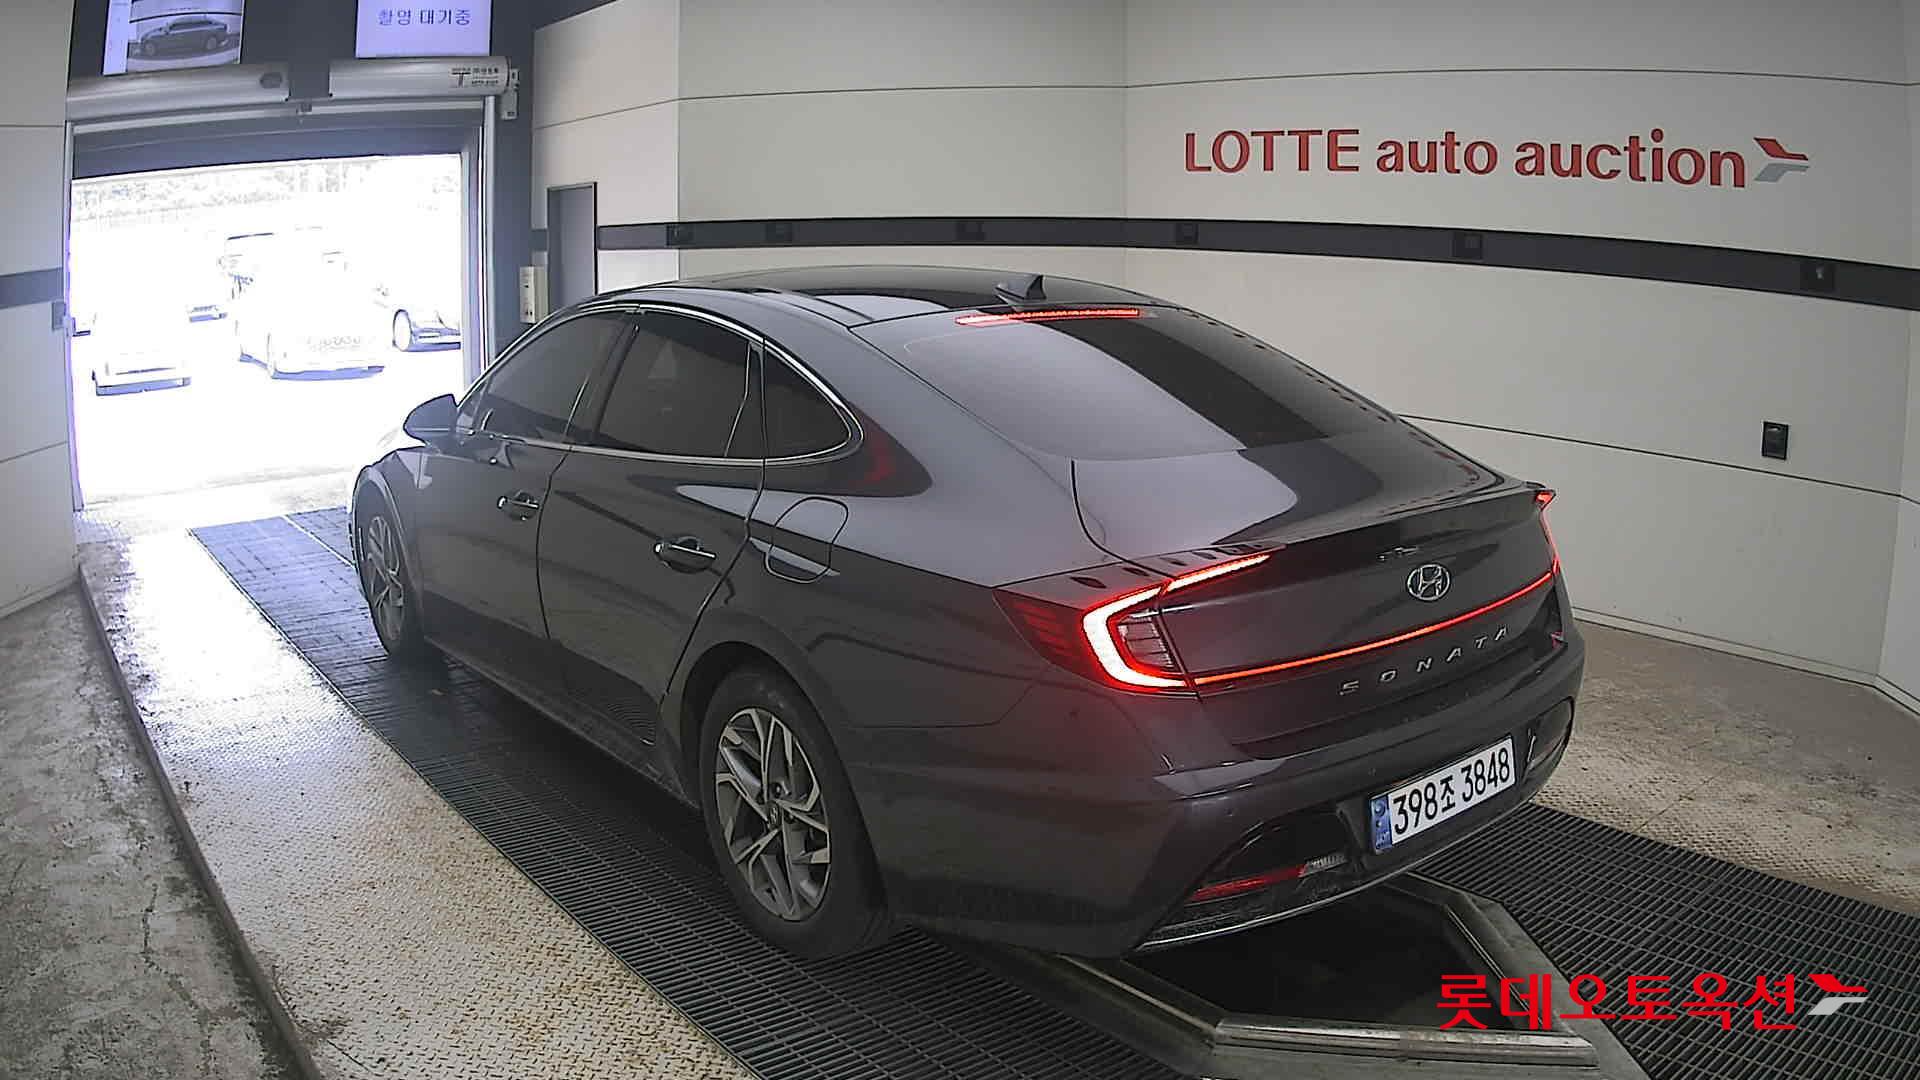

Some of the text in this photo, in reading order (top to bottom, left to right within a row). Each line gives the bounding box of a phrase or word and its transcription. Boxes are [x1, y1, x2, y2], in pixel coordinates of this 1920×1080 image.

[420, 8, 471, 26] 대기중
[1185, 128, 1746, 188] LOTTE auto auction
[1338, 624, 1508, 696] SONATA
[1393, 747, 1510, 835] 398조 3848
